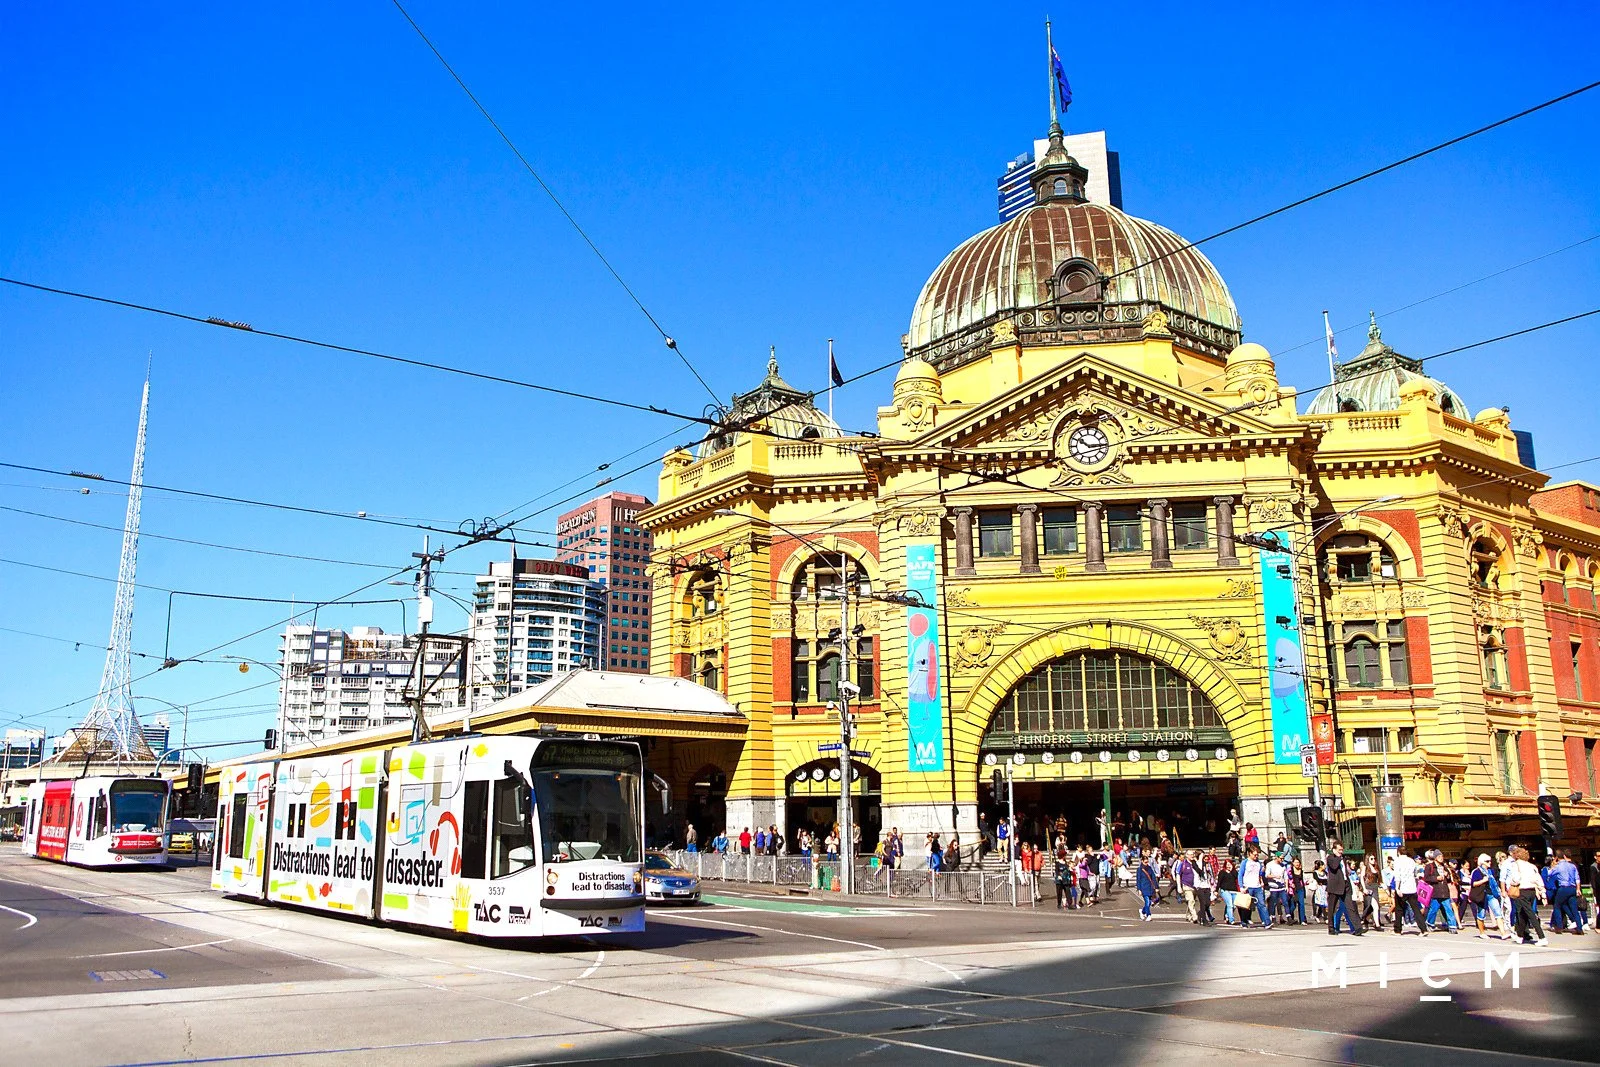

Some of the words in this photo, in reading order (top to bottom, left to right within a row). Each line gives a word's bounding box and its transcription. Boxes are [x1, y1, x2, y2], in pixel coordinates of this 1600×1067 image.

[556, 515, 581, 534] HERALD
[582, 508, 597, 524] SUN
[535, 561, 560, 573] QUAY
[1017, 734, 1072, 744] FLINDERS
[1086, 733, 1128, 743] STREET
[1142, 731, 1193, 742] STATION
[273, 842, 330, 877] Distractions
[333, 845, 357, 879] lead
[361, 848, 373, 881] to
[386, 848, 443, 888] disaster.
[578, 872, 625, 881] Distractions
[488, 887, 506, 895] 3537
[572, 882, 590, 891] lead
[593, 883, 602, 891] to
[474, 900, 501, 923] TAC
[577, 914, 603, 927] TAC
